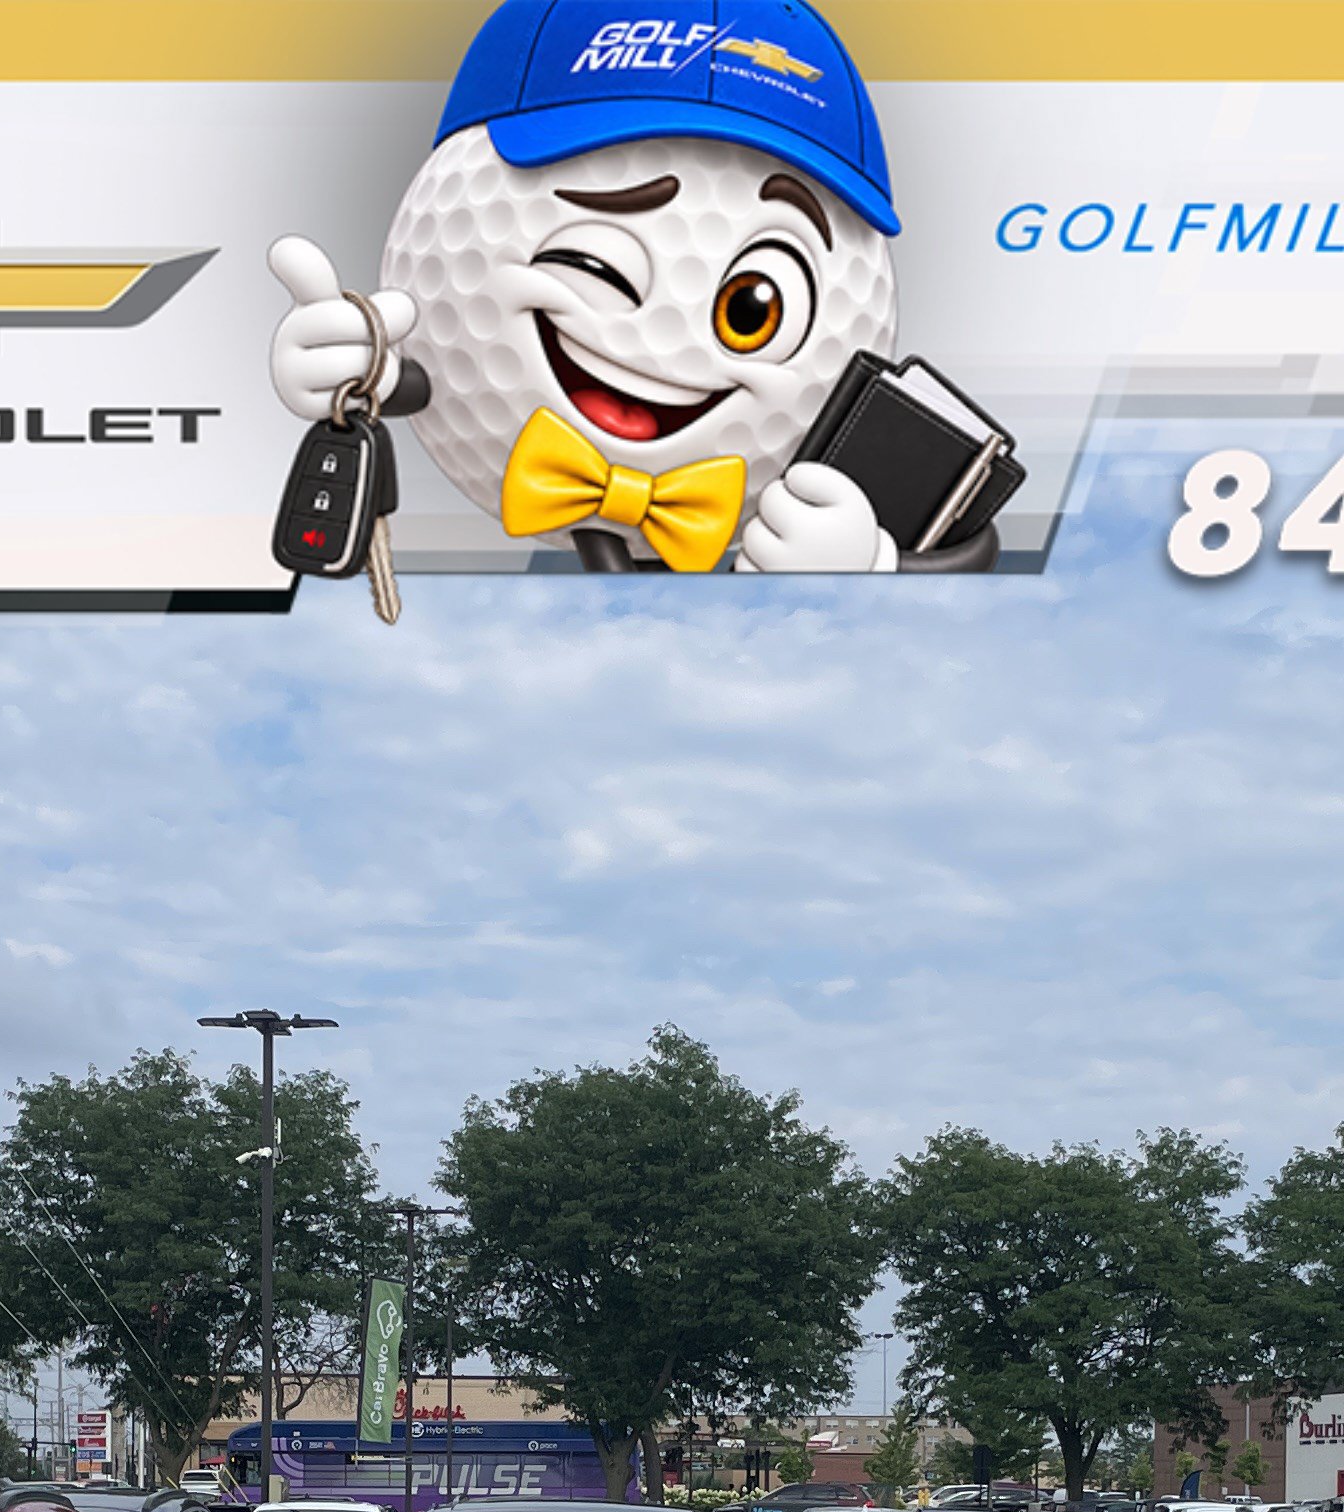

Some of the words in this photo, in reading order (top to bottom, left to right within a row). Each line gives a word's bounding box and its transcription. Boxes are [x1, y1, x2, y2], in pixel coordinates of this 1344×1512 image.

[370, 1343, 389, 1424] CarBravo
[425, 1426, 484, 1435] Hybri-Electric
[539, 1442, 558, 1450] pace
[411, 1464, 547, 1496] PULSE
